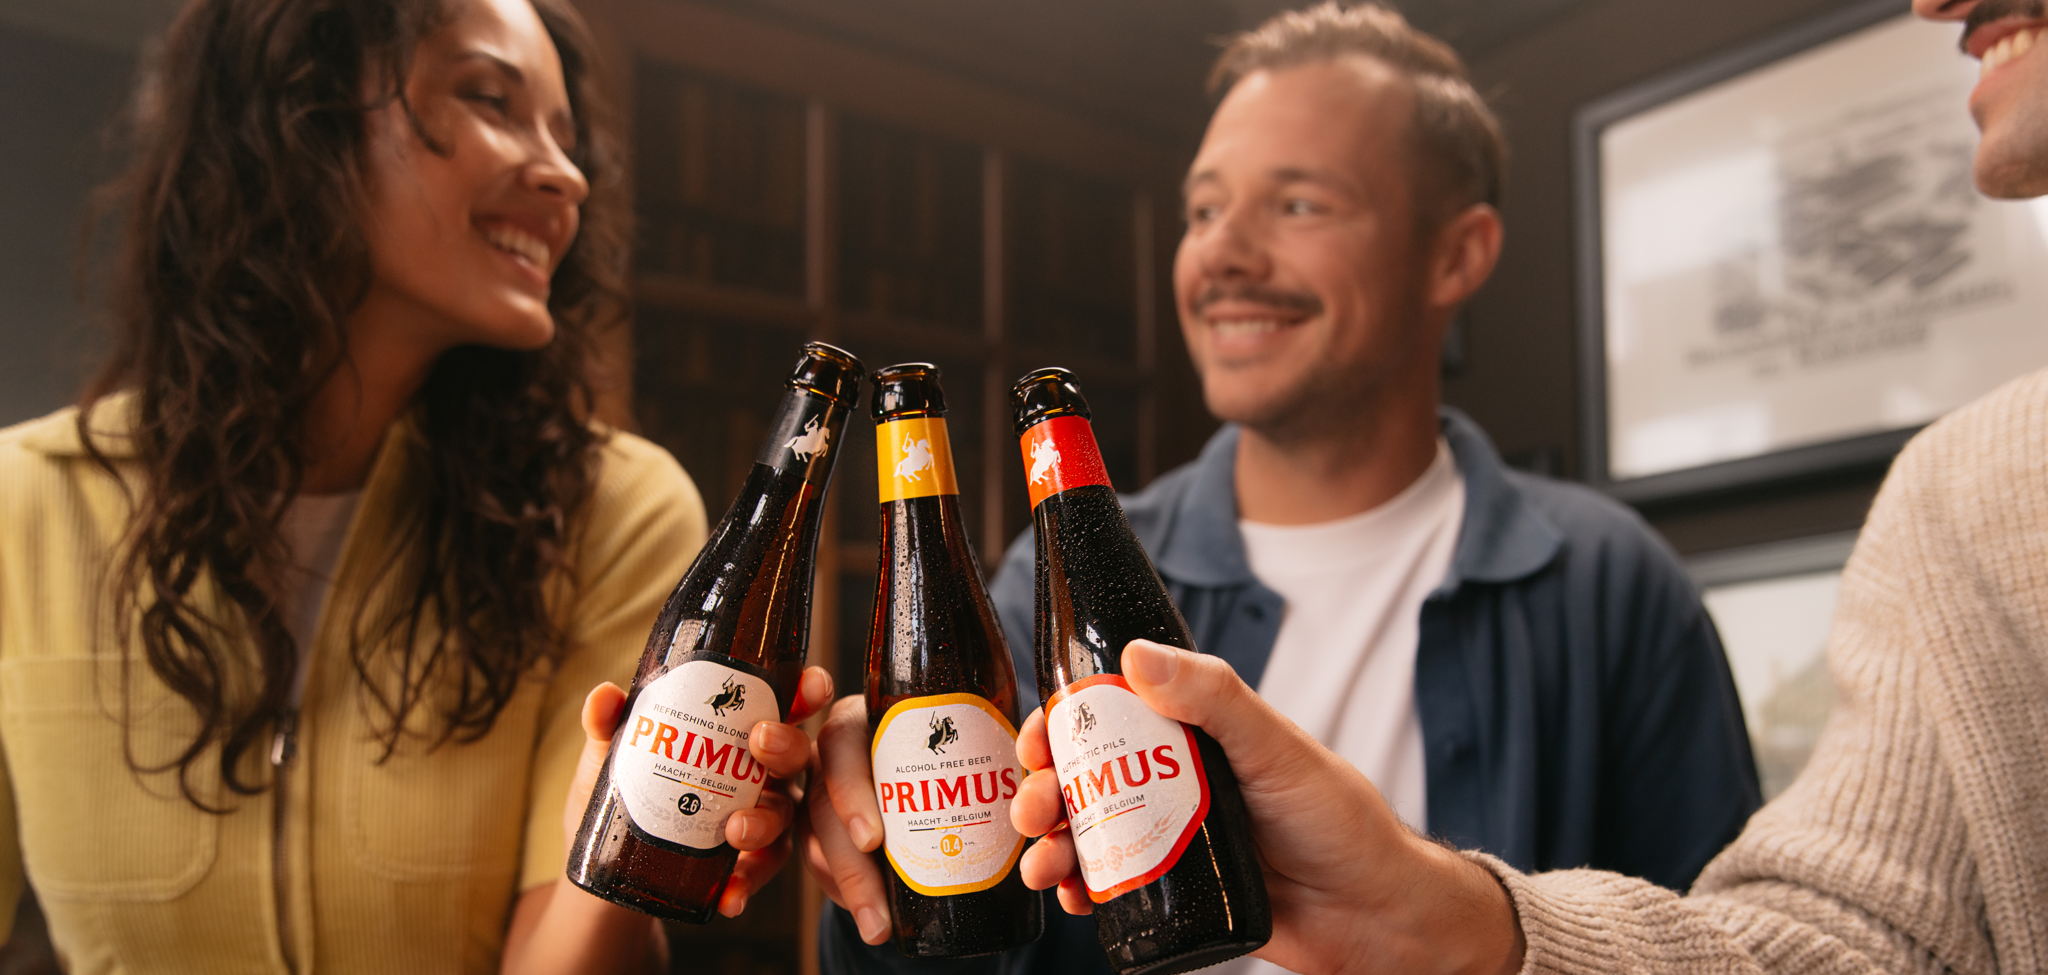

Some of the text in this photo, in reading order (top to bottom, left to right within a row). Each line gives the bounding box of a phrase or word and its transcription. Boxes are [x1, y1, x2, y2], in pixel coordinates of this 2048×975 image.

[654, 703, 749, 740] REFRESHING BLOND
[629, 715, 765, 785] PRIMUS
[1102, 737, 1127, 752] PILS
[895, 755, 993, 774] ALCOHOL FREE BEER
[654, 762, 693, 781] HAACHT
[700, 777, 737, 793] BELGIUM
[1063, 744, 1181, 820] RIMUS
[879, 767, 1018, 814] PRIMUS
[679, 796, 700, 813] 2.6
[1103, 794, 1145, 814] BELGIUM
[907, 817, 941, 827] HAACHT
[951, 810, 992, 824] BELGIUM
[942, 838, 961, 853] 0.4
